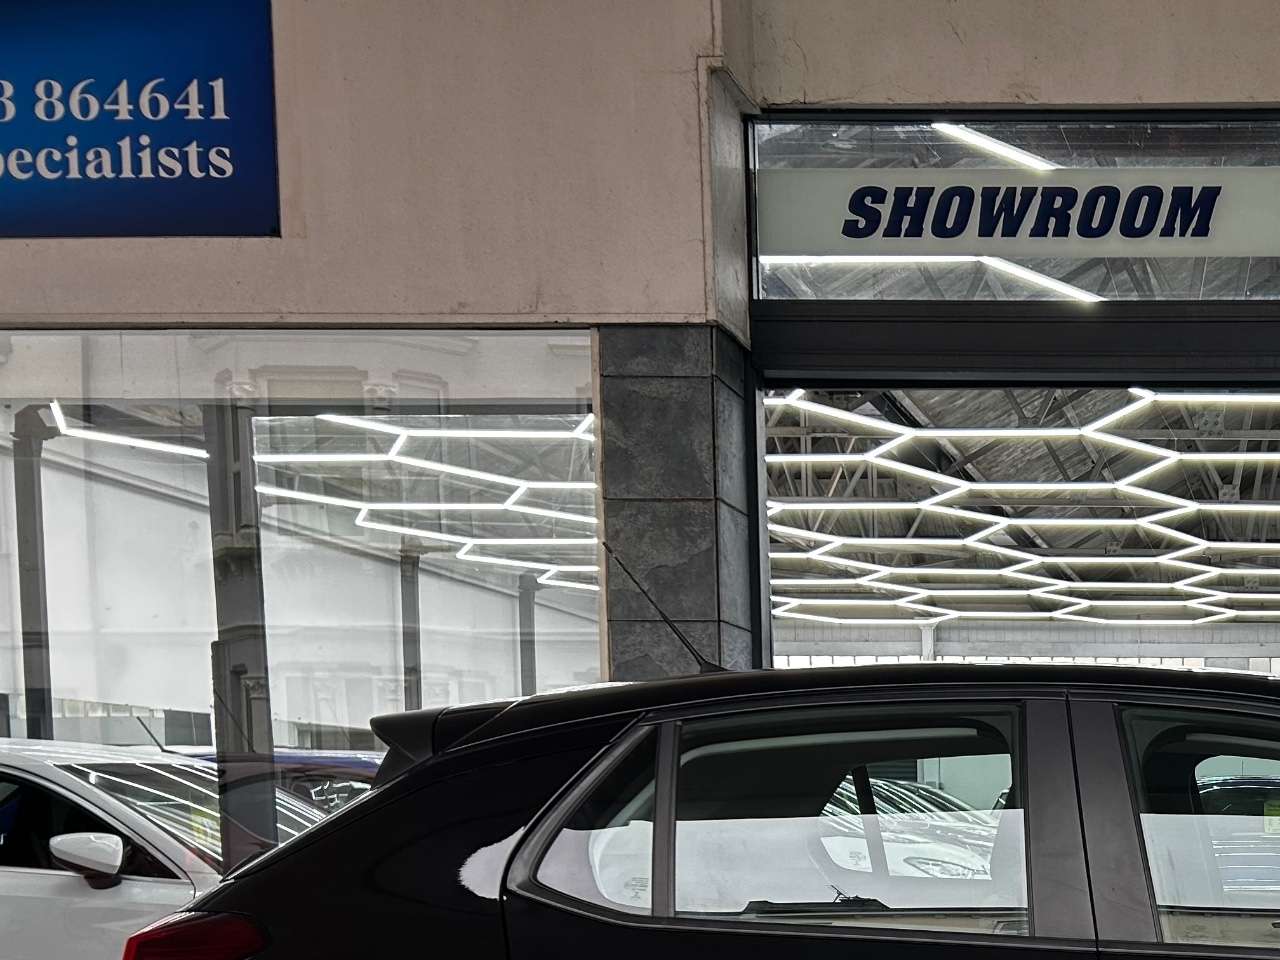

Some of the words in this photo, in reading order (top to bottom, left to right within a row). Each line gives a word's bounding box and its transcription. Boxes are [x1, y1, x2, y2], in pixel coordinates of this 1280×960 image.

[34, 77, 231, 121] 864641
[0, 134, 234, 180] ecialists
[841, 185, 1223, 239] SHOWROOM
